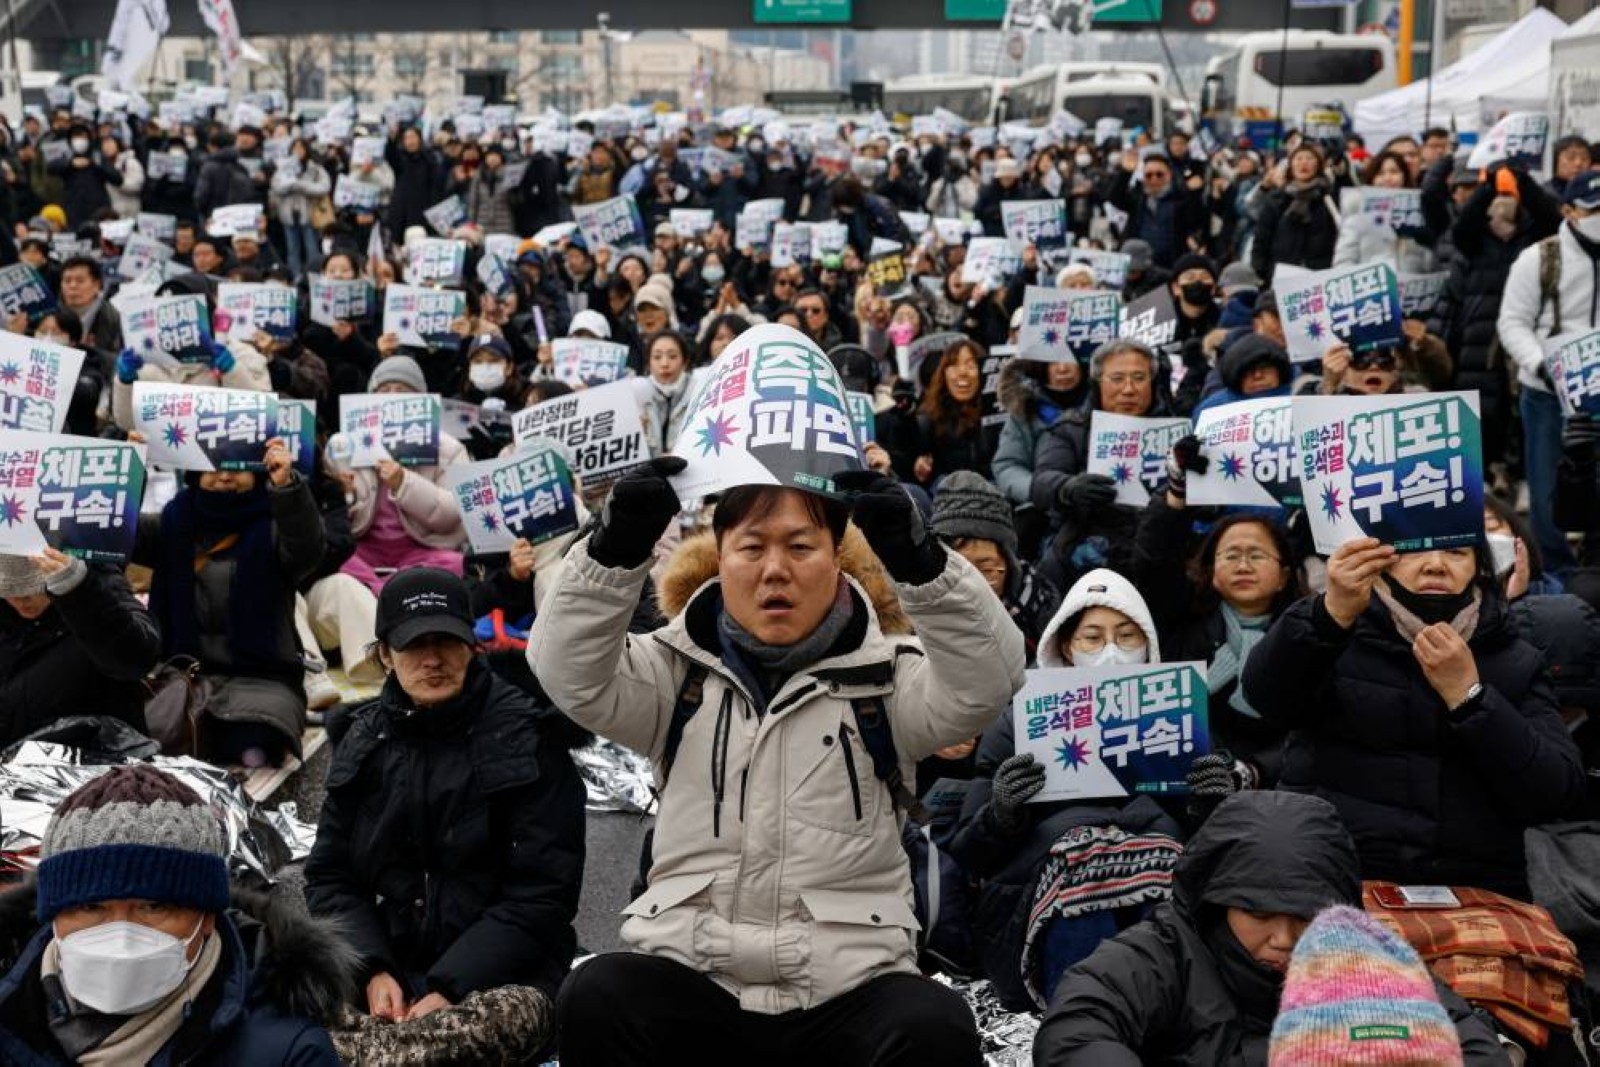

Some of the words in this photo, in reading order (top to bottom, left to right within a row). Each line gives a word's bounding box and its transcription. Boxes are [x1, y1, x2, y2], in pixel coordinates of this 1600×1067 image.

[1328, 266, 1388, 307] 체포!
[1331, 294, 1392, 337] 구속!
[159, 323, 201, 352] 하라
[1560, 334, 1600, 374] 체포
[197, 393, 267, 415] 체포!
[197, 412, 267, 449] 구속!
[382, 420, 432, 450] 구속!
[750, 400, 858, 460] 파면
[1254, 407, 1293, 444] 해
[1301, 421, 1345, 450] 내란수괴
[1350, 400, 1461, 466] 체포!
[0, 466, 35, 488] 석열
[40, 448, 132, 488] 체포!
[494, 452, 557, 500] 체포!
[1253, 447, 1299, 483] 하
[1303, 443, 1345, 481] 윤석열
[501, 482, 565, 532] 구속!
[1352, 455, 1466, 523] 구속!
[36, 489, 127, 531] 구속!
[1026, 684, 1093, 715] 내란수괴
[1098, 668, 1193, 723] 체포!
[1027, 703, 1093, 740] 윤석열
[1101, 713, 1195, 768] 구속!
